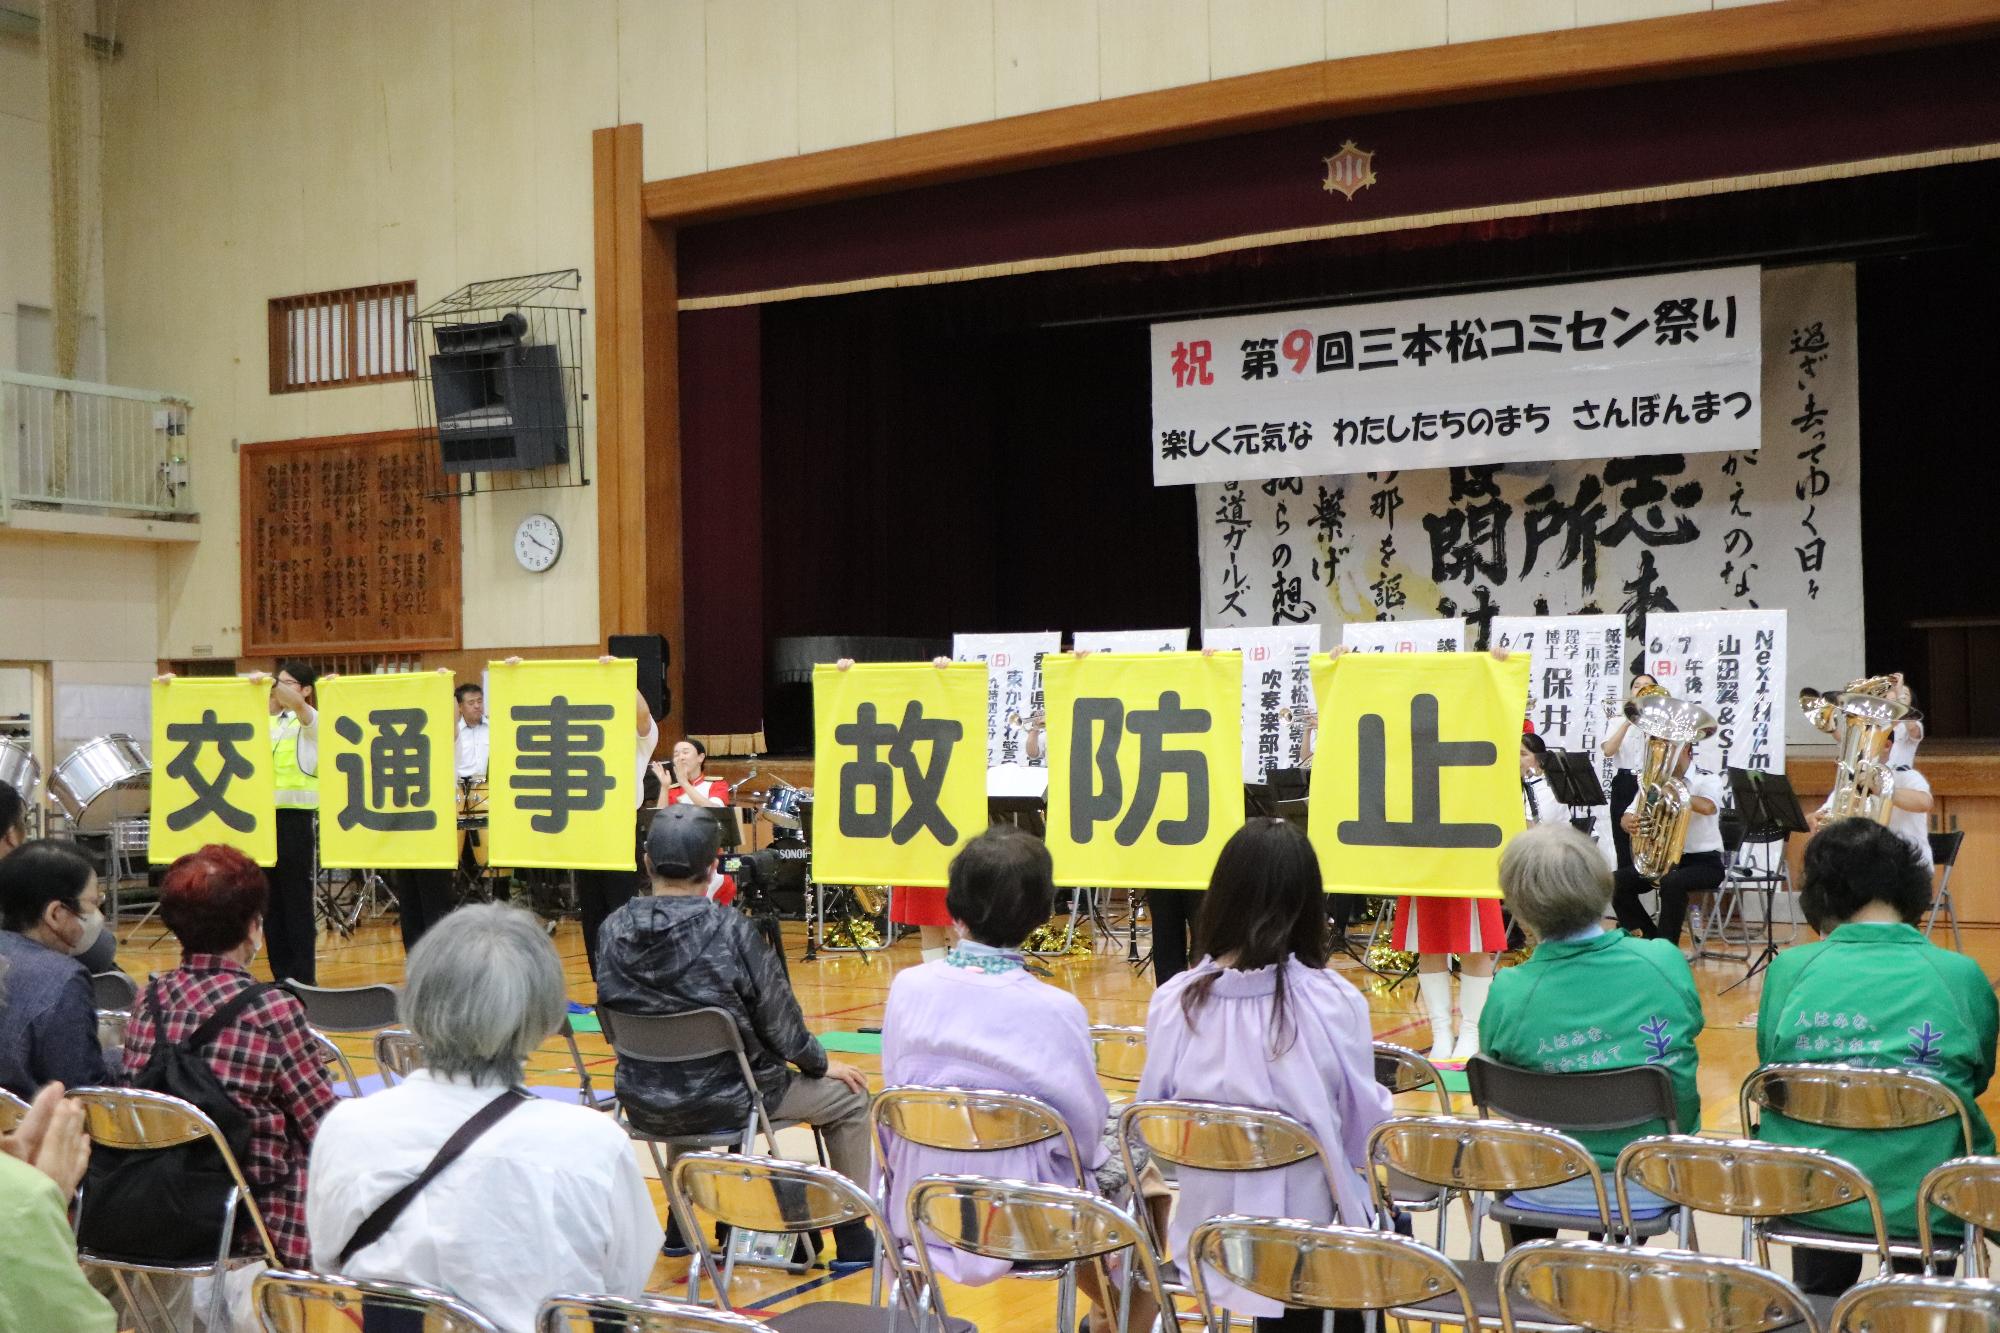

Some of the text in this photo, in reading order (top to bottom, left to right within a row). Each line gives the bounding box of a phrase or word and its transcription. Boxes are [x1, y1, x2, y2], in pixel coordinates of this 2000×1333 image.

[1171, 295, 1738, 388] 祝 第9回三本松コミセン祭り
[1161, 388, 1754, 461] 楽しく元気な わたしたちのまち さんぼんまつ
[1540, 666, 1575, 752] 保井
[166, 690, 1503, 849] 交 通 事 故 防 止
